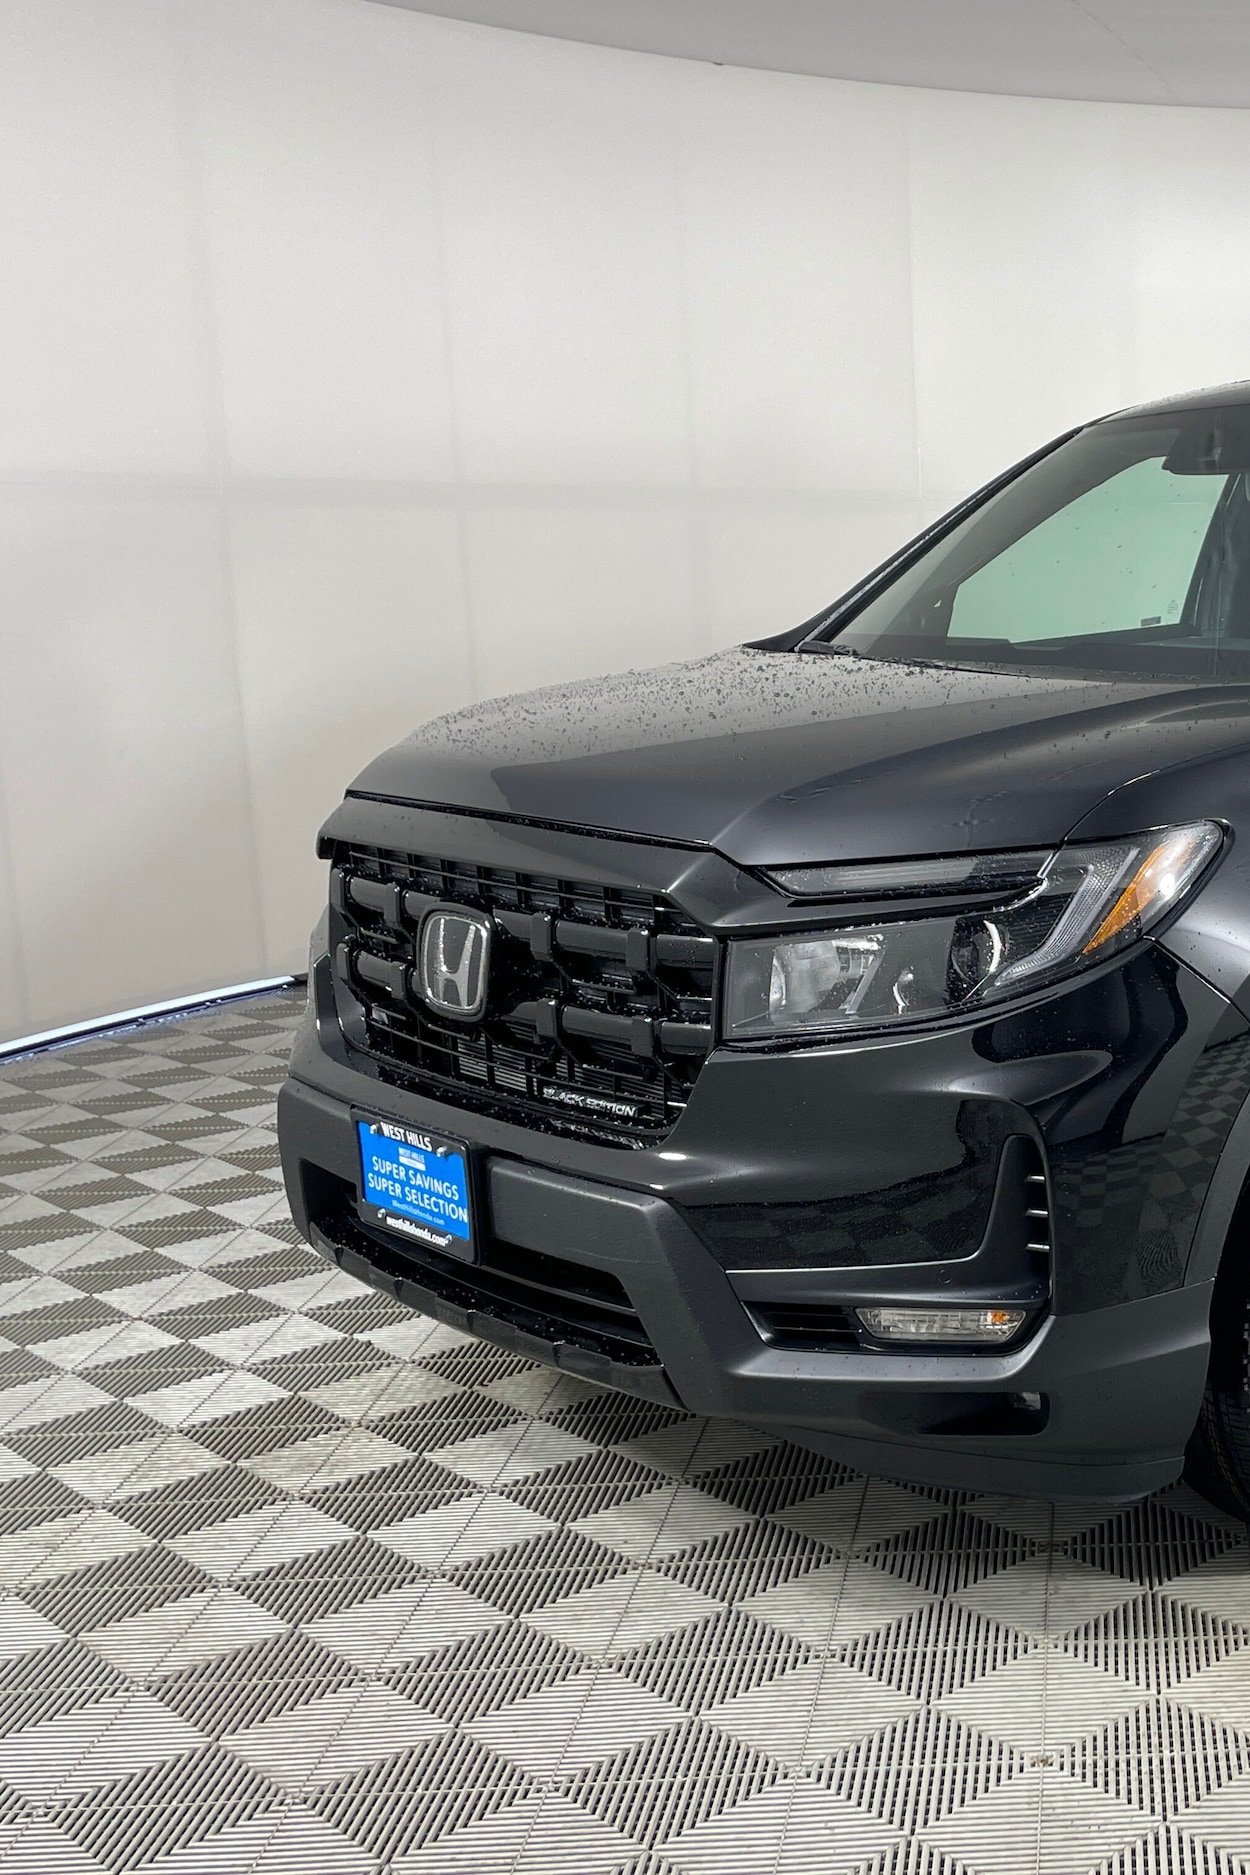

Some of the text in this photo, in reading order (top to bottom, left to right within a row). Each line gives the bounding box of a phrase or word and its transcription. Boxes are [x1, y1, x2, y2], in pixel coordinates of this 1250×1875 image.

[380, 1121, 432, 1152] WEST HILLS
[368, 1172, 468, 1223] SUPER SELECTION
[372, 1155, 459, 1201] SUPER SAVINGS
